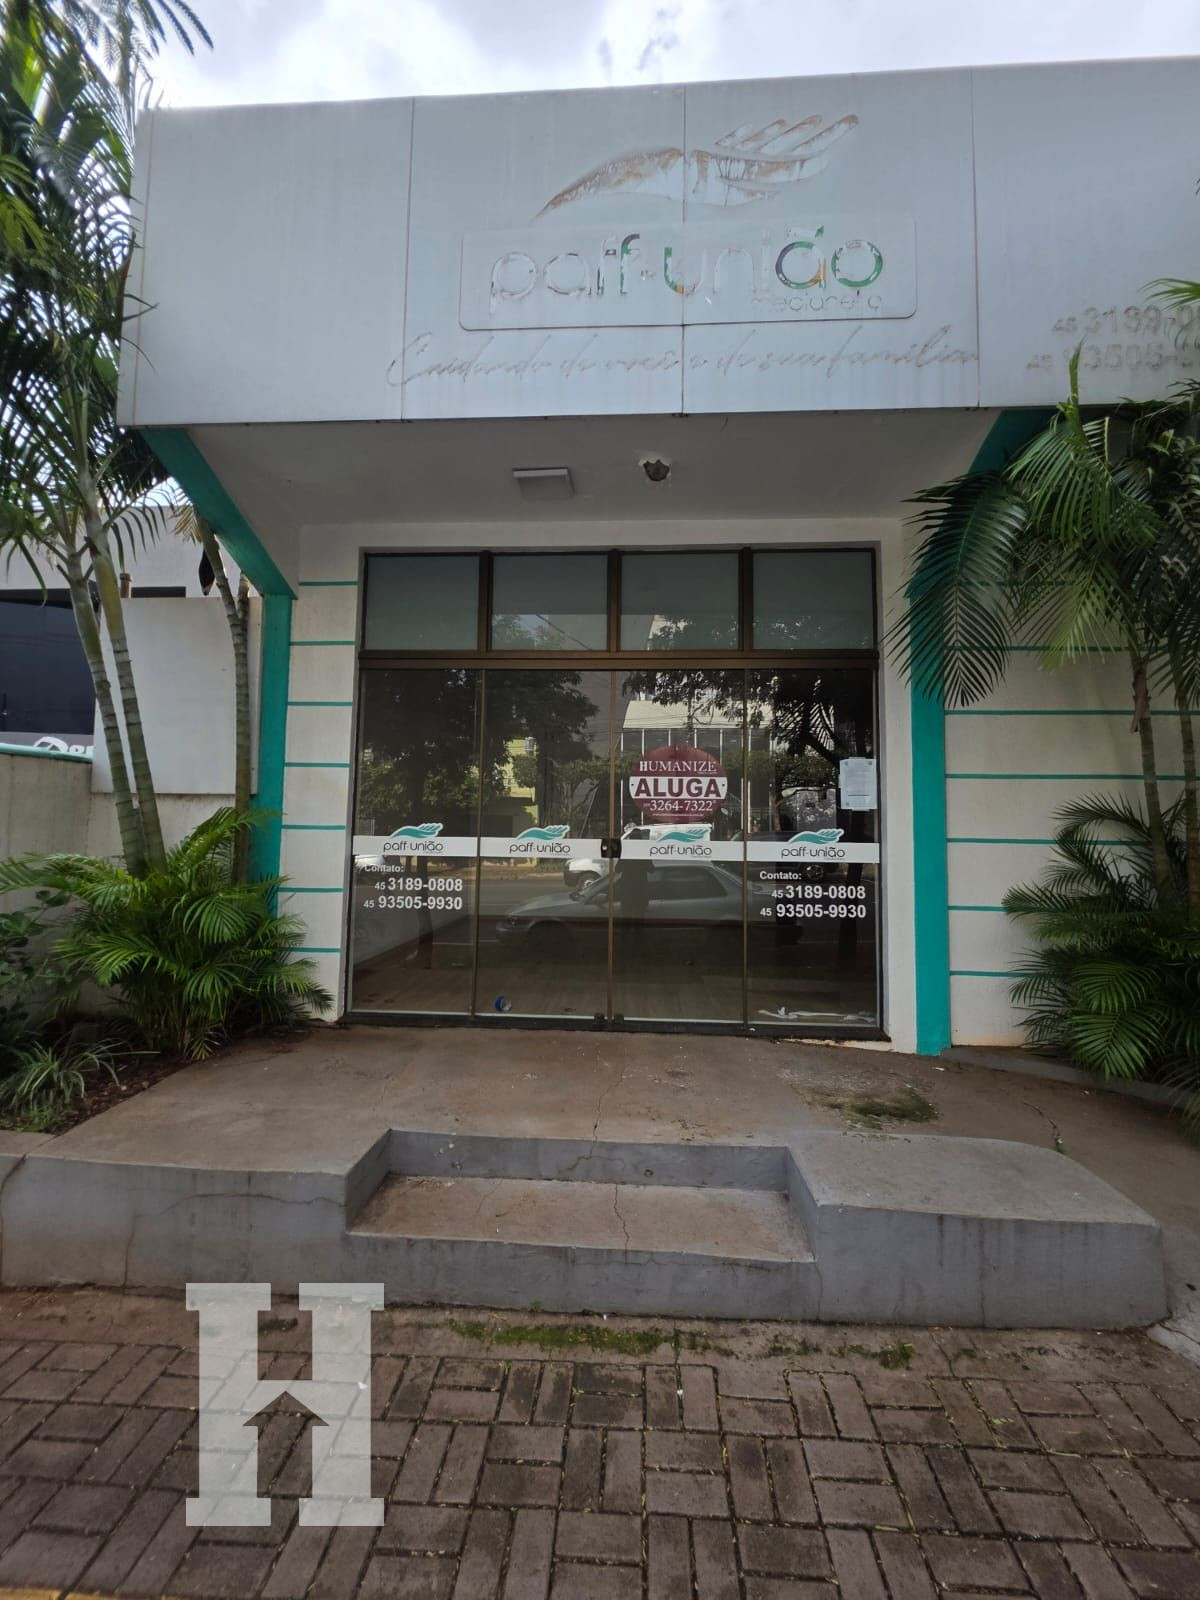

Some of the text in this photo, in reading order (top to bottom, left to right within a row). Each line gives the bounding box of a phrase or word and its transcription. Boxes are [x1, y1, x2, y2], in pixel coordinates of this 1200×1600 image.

[639, 760, 718, 773] HUMANIZE
[634, 778, 722, 798] ALUGA
[650, 799, 713, 811] 3264-7322
[759, 870, 802, 880] Contato:
[374, 877, 463, 892] 45 3189-0808
[771, 885, 866, 899] 45 3189-0808
[363, 895, 463, 910] 45 93505-9930
[760, 903, 867, 918] 45 93505-9930
